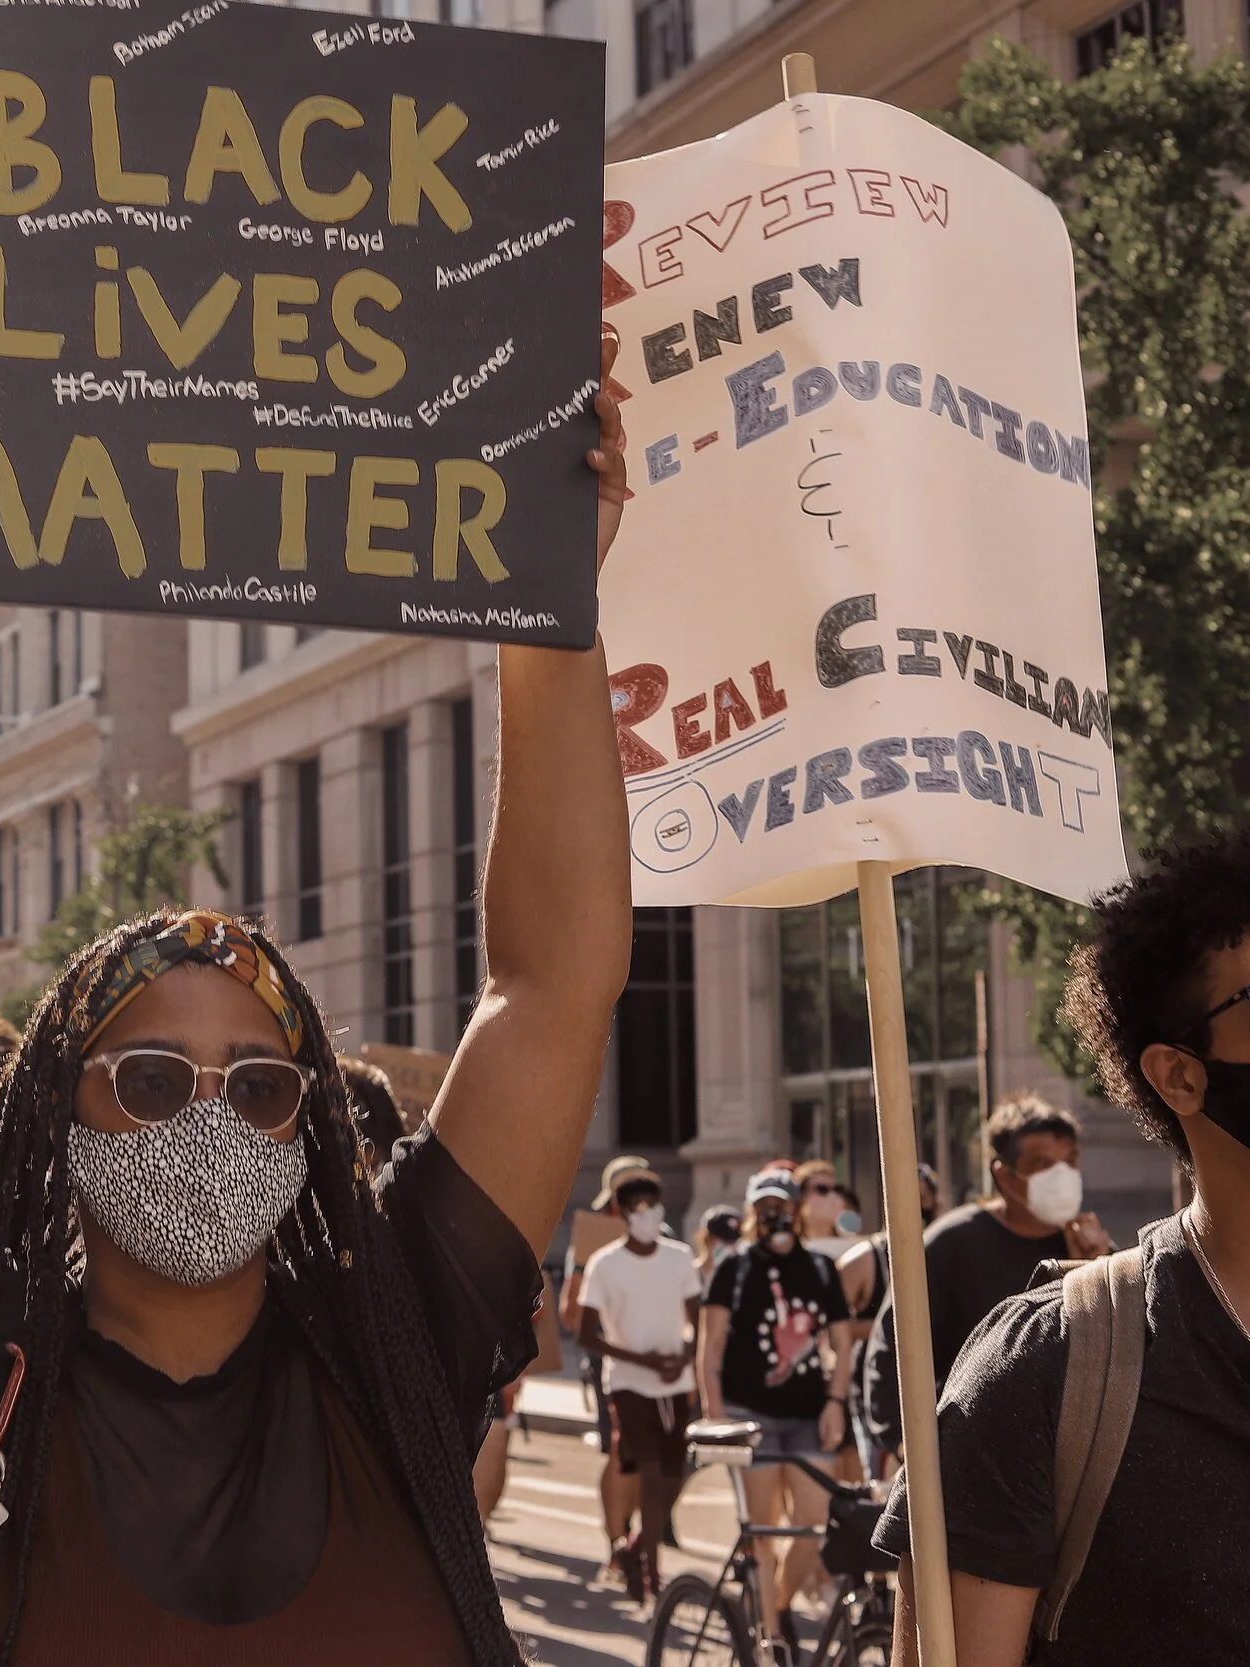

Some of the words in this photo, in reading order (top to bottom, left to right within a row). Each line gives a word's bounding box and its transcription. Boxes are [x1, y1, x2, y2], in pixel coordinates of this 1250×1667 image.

[367, 20, 415, 45] Ford
[17, 208, 114, 237] Breonna
[115, 205, 193, 233] Taylor
[238, 217, 314, 247] George
[324, 227, 385, 257] Floyd
[610, 258, 862, 400] ENEW
[52, 369, 260, 405] #SayTheirNames
[417, 388, 457, 427] Eric
[452, 336, 515, 400] Garner
[159, 572, 243, 604] Philando
[244, 575, 317, 605] Castile
[401, 601, 483, 626] Natasha
[485, 606, 561, 630] McKenna
